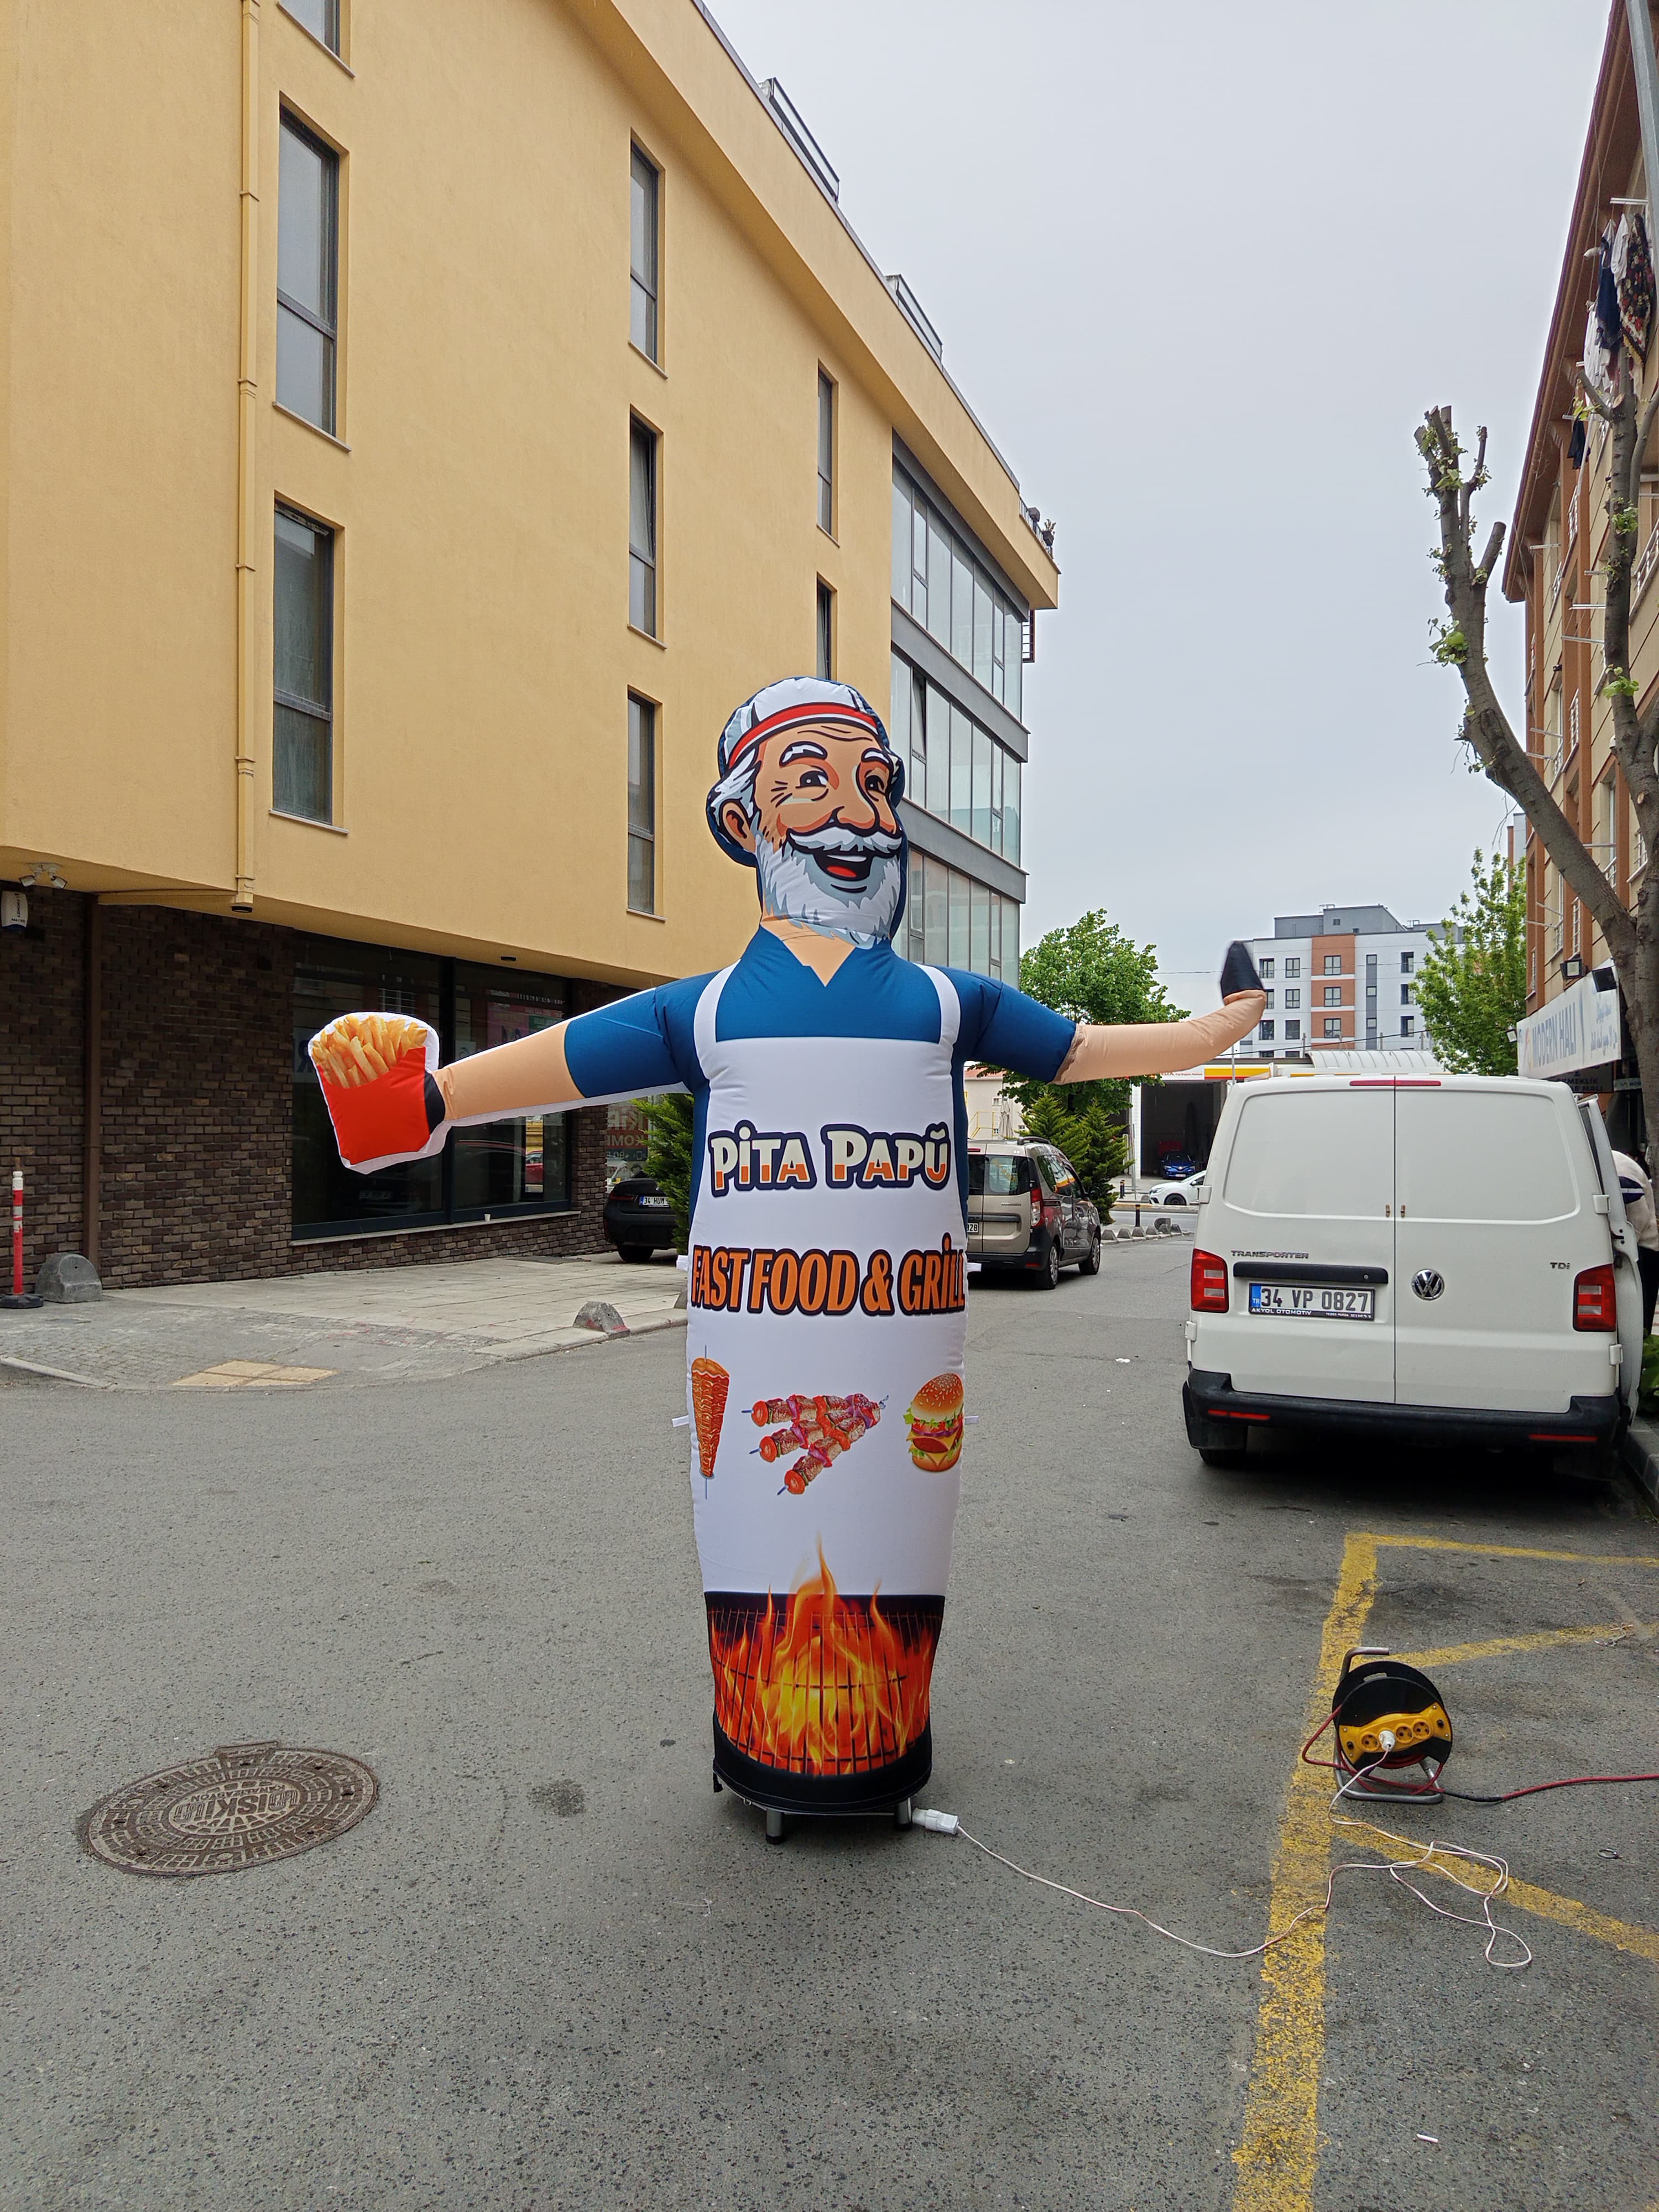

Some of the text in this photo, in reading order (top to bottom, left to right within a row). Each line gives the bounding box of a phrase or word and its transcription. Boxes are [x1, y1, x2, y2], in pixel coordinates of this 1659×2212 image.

[1231, 1250, 1309, 1259] TRANSPORTER
[692, 1245, 751, 1311] FAST
[748, 1249, 860, 1315] FOOD
[860, 1249, 895, 1315] &
[1260, 1288, 1369, 1312] 34 VP 0827
